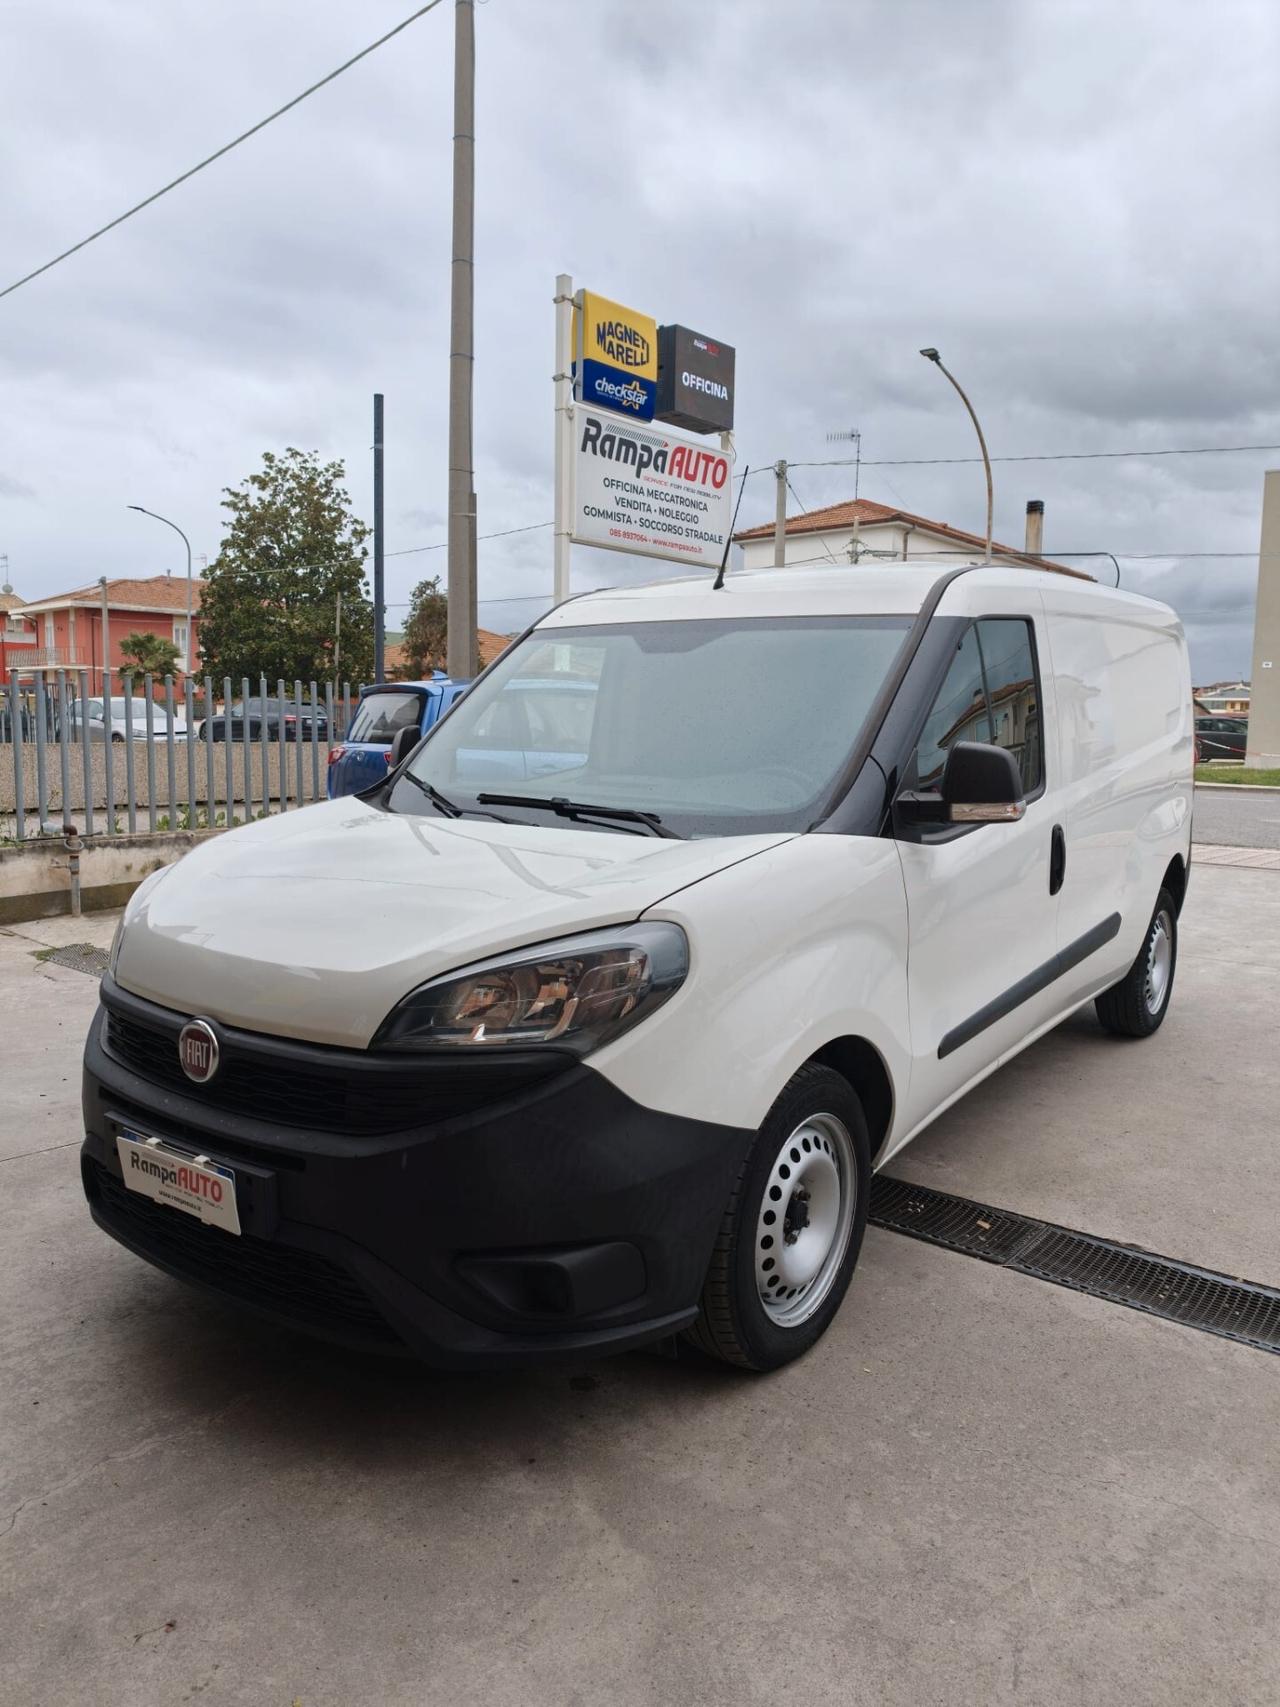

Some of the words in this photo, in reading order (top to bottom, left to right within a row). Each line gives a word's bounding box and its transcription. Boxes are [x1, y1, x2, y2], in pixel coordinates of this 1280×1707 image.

[595, 377, 648, 405] checkstar
[682, 371, 729, 401] OFFICINA
[603, 477, 645, 496] OFFICINA
[646, 488, 708, 512] MECCATRONICA
[583, 505, 632, 525] GOMMISTA
[639, 517, 684, 536] SOCCORSO
[684, 527, 723, 545] STRADALE
[614, 496, 652, 514] VENDITA
[658, 507, 699, 525] NOLEGGIO
[186, 1038, 208, 1069] FIAT
